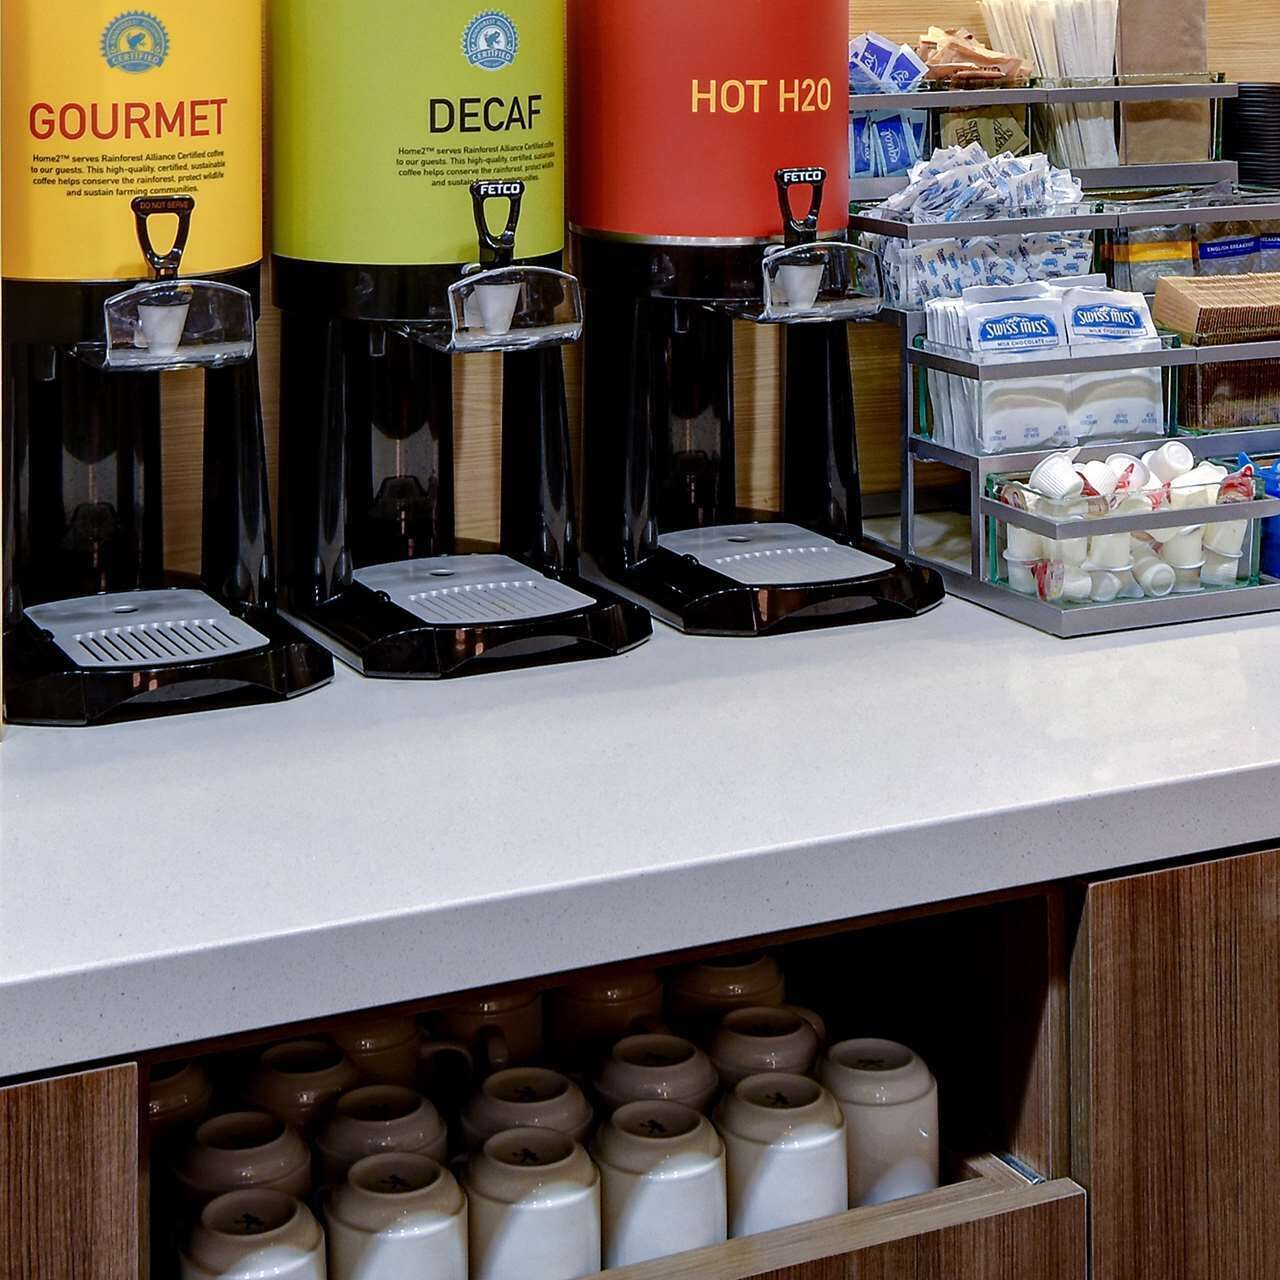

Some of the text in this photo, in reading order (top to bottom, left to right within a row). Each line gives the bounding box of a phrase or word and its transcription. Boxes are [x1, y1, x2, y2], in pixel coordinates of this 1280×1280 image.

[472, 50, 511, 61] CERTIFIED
[690, 79, 768, 113] HOT
[28, 98, 228, 140] GOURMET
[428, 94, 543, 134] DECAF
[436, 147, 461, 155] serves
[463, 145, 499, 155] Rainforest
[879, 127, 900, 163] equal
[72, 155, 99, 163] serves
[101, 153, 143, 163] Rainforest
[145, 152, 176, 161] Alliance
[177, 150, 206, 160] Certified
[396, 158, 403, 166] to
[450, 157, 466, 166] This
[31, 166, 38, 174] to
[87, 165, 104, 174] This
[398, 169, 421, 177] coffee
[423, 168, 444, 178] helps
[446, 168, 479, 176] conserve
[480, 167, 492, 175] the
[33, 177, 56, 186] coffee
[58, 176, 81, 187] helps
[82, 177, 120, 185] conserve
[121, 176, 135, 185] the
[177, 172, 202, 183] protect
[783, 170, 822, 183] FETCO
[431, 179, 446, 187] and
[66, 187, 82, 197] and
[83, 187, 114, 197] sustain
[115, 186, 148, 197] farming
[479, 182, 521, 196] FETCO
[1206, 245, 1229, 253] ENGLISH
[1011, 338, 1045, 348] CHOCOLATE
